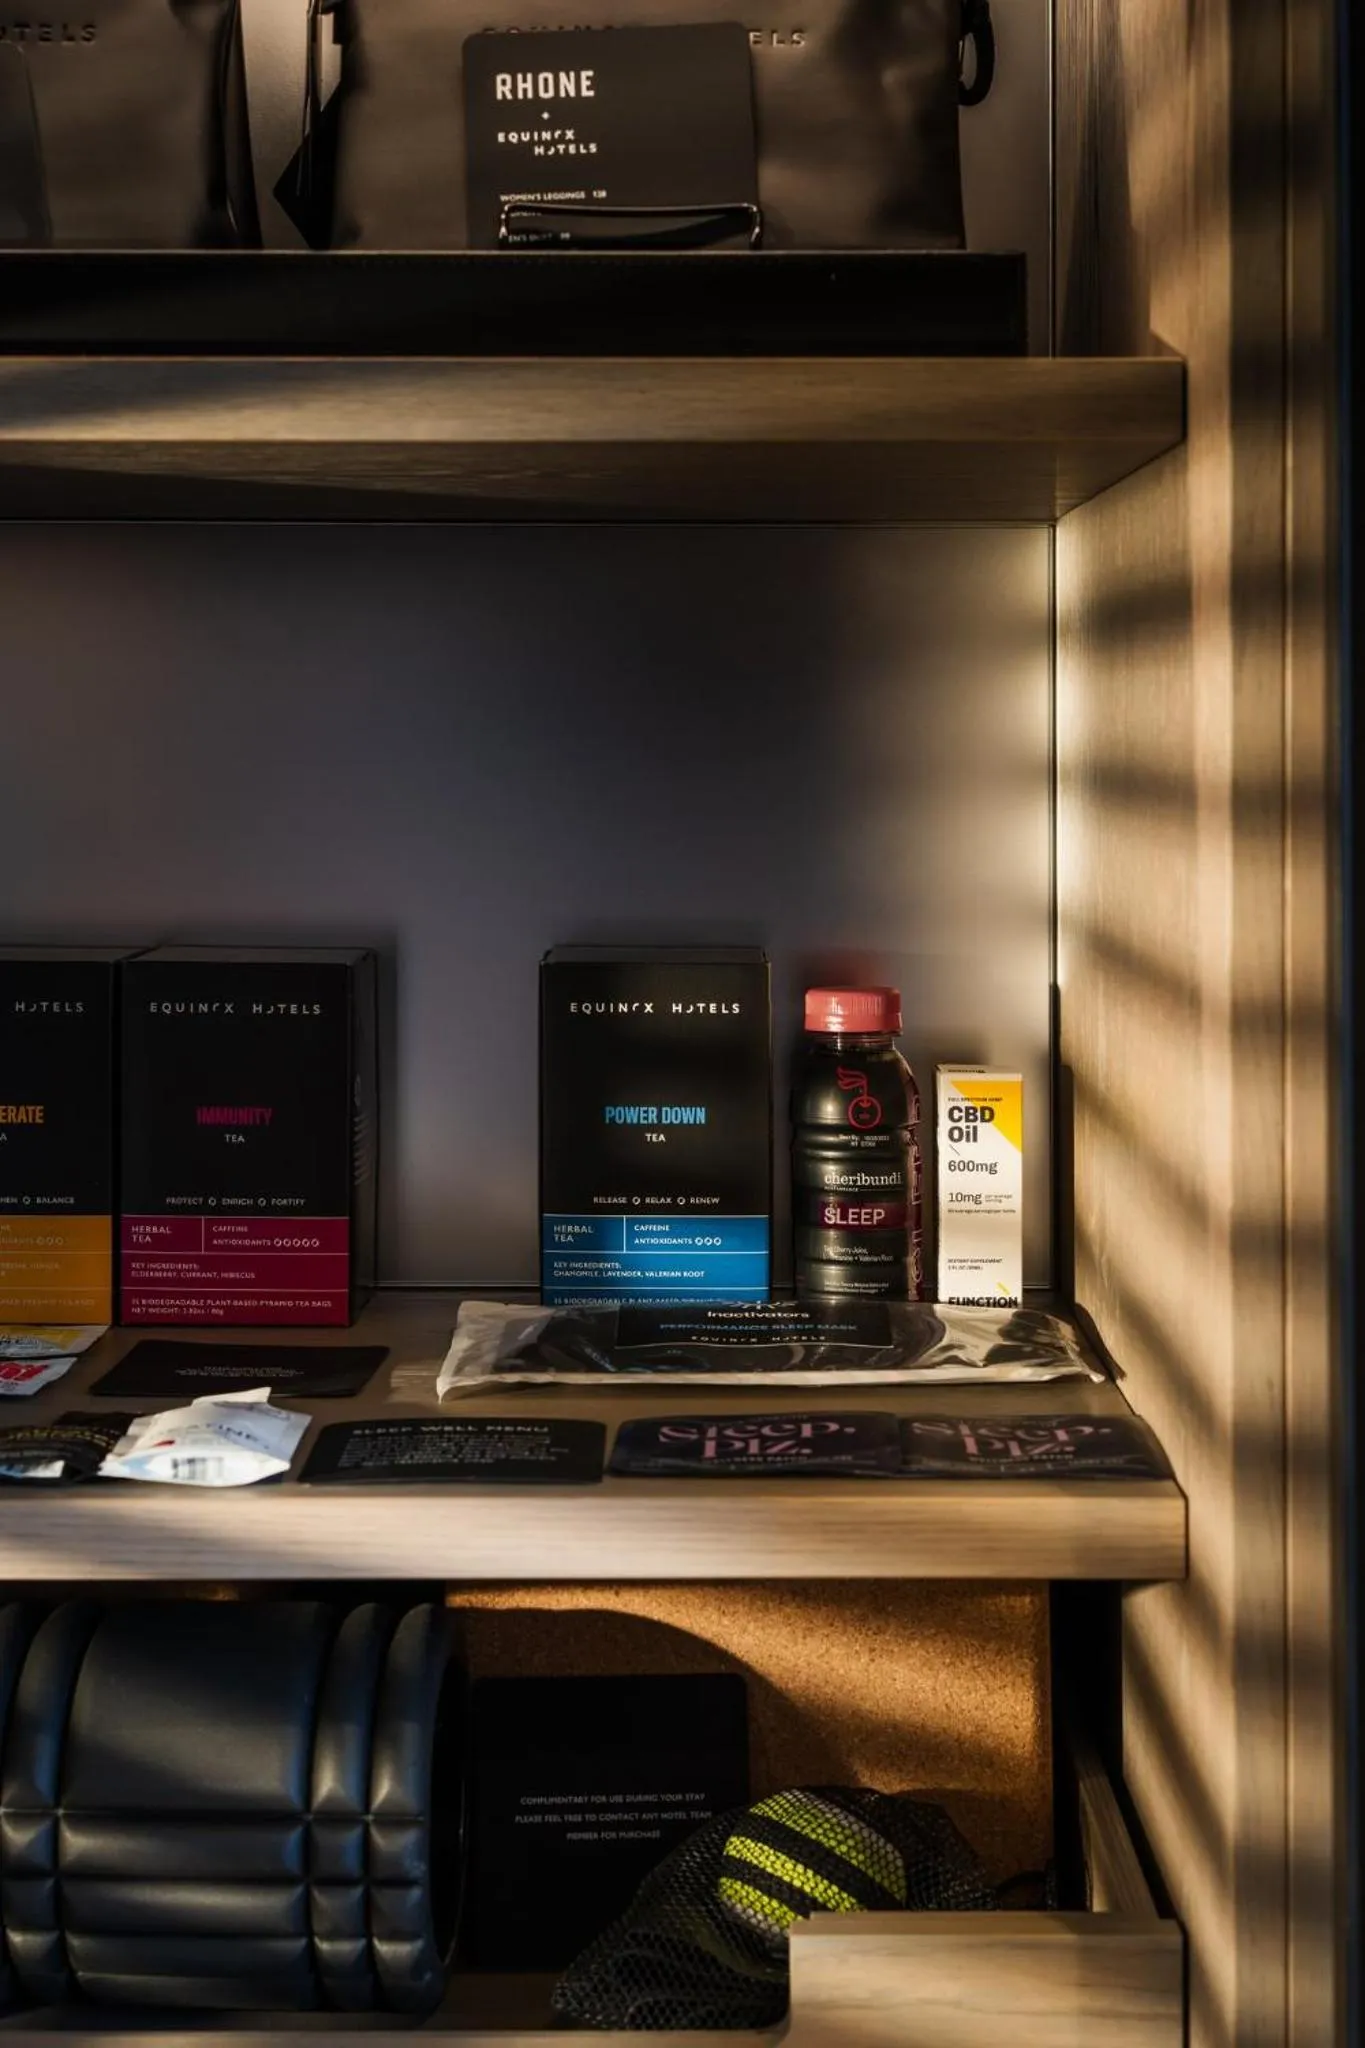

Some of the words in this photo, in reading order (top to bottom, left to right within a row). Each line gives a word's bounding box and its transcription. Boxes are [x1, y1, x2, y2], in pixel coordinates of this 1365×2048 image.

[495, 69, 596, 101] RHONE
[500, 191, 542, 202] WOMEN'S
[543, 190, 586, 201] LEGGINGS
[0, 1105, 45, 1124] ERATE
[196, 1105, 274, 1126] IMMUNITY
[604, 1106, 659, 1125] POWER
[661, 1106, 706, 1125] DOWN
[947, 1105, 996, 1124] CBD
[223, 1133, 246, 1144] TEA
[644, 1133, 666, 1143] TEA
[947, 1125, 979, 1144] Oil
[947, 1159, 999, 1175] 600mg
[823, 1171, 903, 1186] cheribundi
[36, 1196, 76, 1205] BALANCE
[165, 1196, 204, 1206] PROTECT
[221, 1197, 254, 1206] ENRICH
[270, 1198, 307, 1206] FORTIFY
[593, 1196, 629, 1205] RELEASE
[644, 1196, 673, 1205] RELAX
[689, 1196, 721, 1205] RENEW
[948, 1191, 983, 1205] 10mg
[823, 1206, 886, 1226] SLEEP
[131, 1225, 173, 1234] HERBAL
[212, 1225, 249, 1233] CAFFEINE
[553, 1224, 595, 1234] HERBAL
[633, 1224, 671, 1232] CAFFEINE
[131, 1234, 153, 1244] TEA
[212, 1238, 271, 1247] ANTIOXIDANTS
[554, 1234, 575, 1243] TEA
[633, 1237, 694, 1245] ANTIOXIDANTS
[644, 1270, 682, 1278] VALERIAN
[683, 1270, 705, 1278] ROOT
[947, 1296, 1019, 1309] FUNCTION
[659, 1322, 770, 1332] PERFORMANCE
[771, 1323, 816, 1332] SLEEP
[816, 1323, 859, 1332] MASK
[420, 1424, 478, 1433] WELL
[486, 1424, 550, 1433] MENU
[520, 1794, 590, 1806] COMPLIMENTARY
[591, 1794, 607, 1805] FOR
[609, 1794, 625, 1804] USE
[626, 1793, 659, 1804] DURING
[660, 1793, 683, 1803] YOUR
[684, 1792, 706, 1802] STAY
[515, 1813, 543, 1824] PLEASE
[544, 1813, 563, 1824] FEEL
[564, 1813, 583, 1823] FREE
[585, 1813, 598, 1823] TO
[599, 1812, 640, 1822] CONTACT
[641, 1811, 659, 1821] ANY
[660, 1811, 688, 1821] HOTEL
[689, 1810, 713, 1820] TEAM
[565, 1831, 600, 1842] MEMBER
[600, 1831, 617, 1841] FOR
[618, 1829, 662, 1840] PURCHASE
